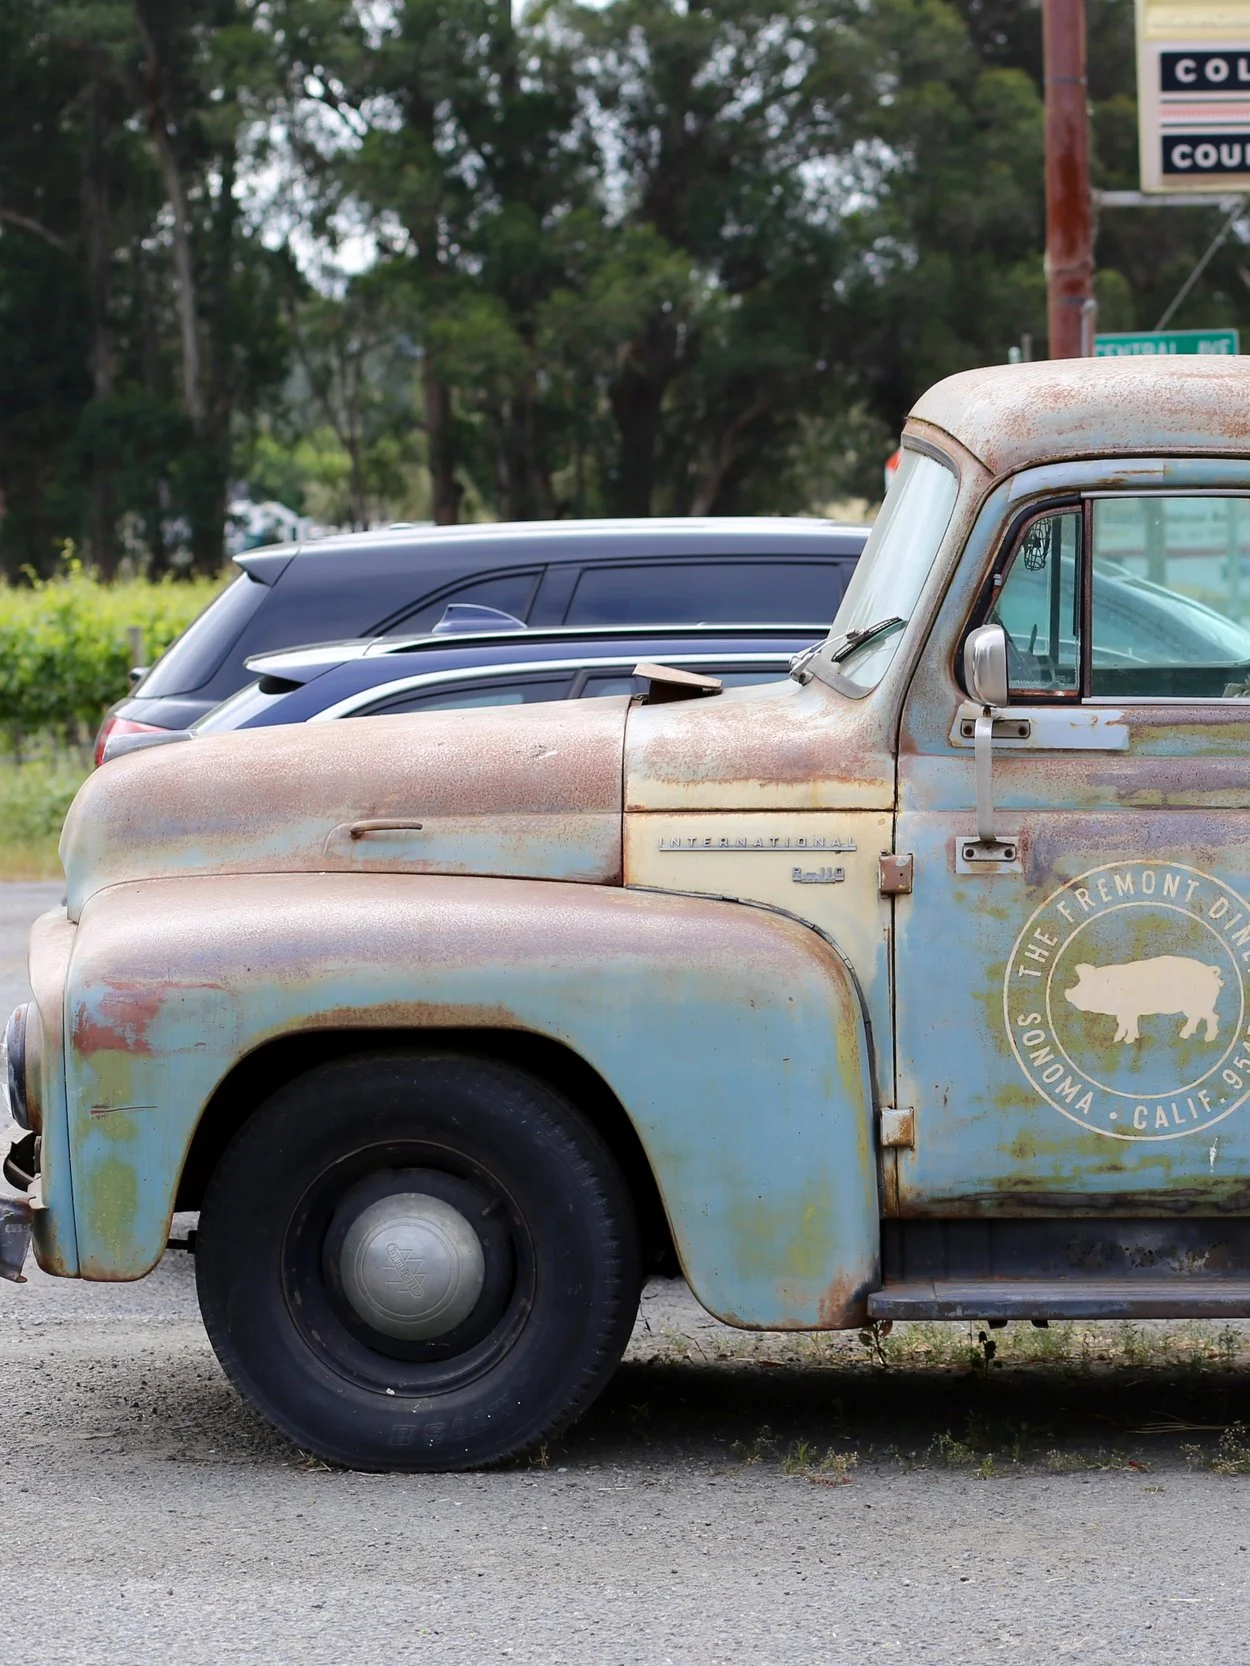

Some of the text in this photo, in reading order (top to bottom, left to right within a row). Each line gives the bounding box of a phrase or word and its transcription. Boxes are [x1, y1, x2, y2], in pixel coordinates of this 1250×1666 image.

[659, 836, 857, 850] INTERNATIONAL
[1018, 927, 1059, 978] THE
[1056, 870, 1200, 923] FREMONT
[1017, 1012, 1094, 1114] SONOMA
[1133, 1090, 1227, 1130] CALIF.
